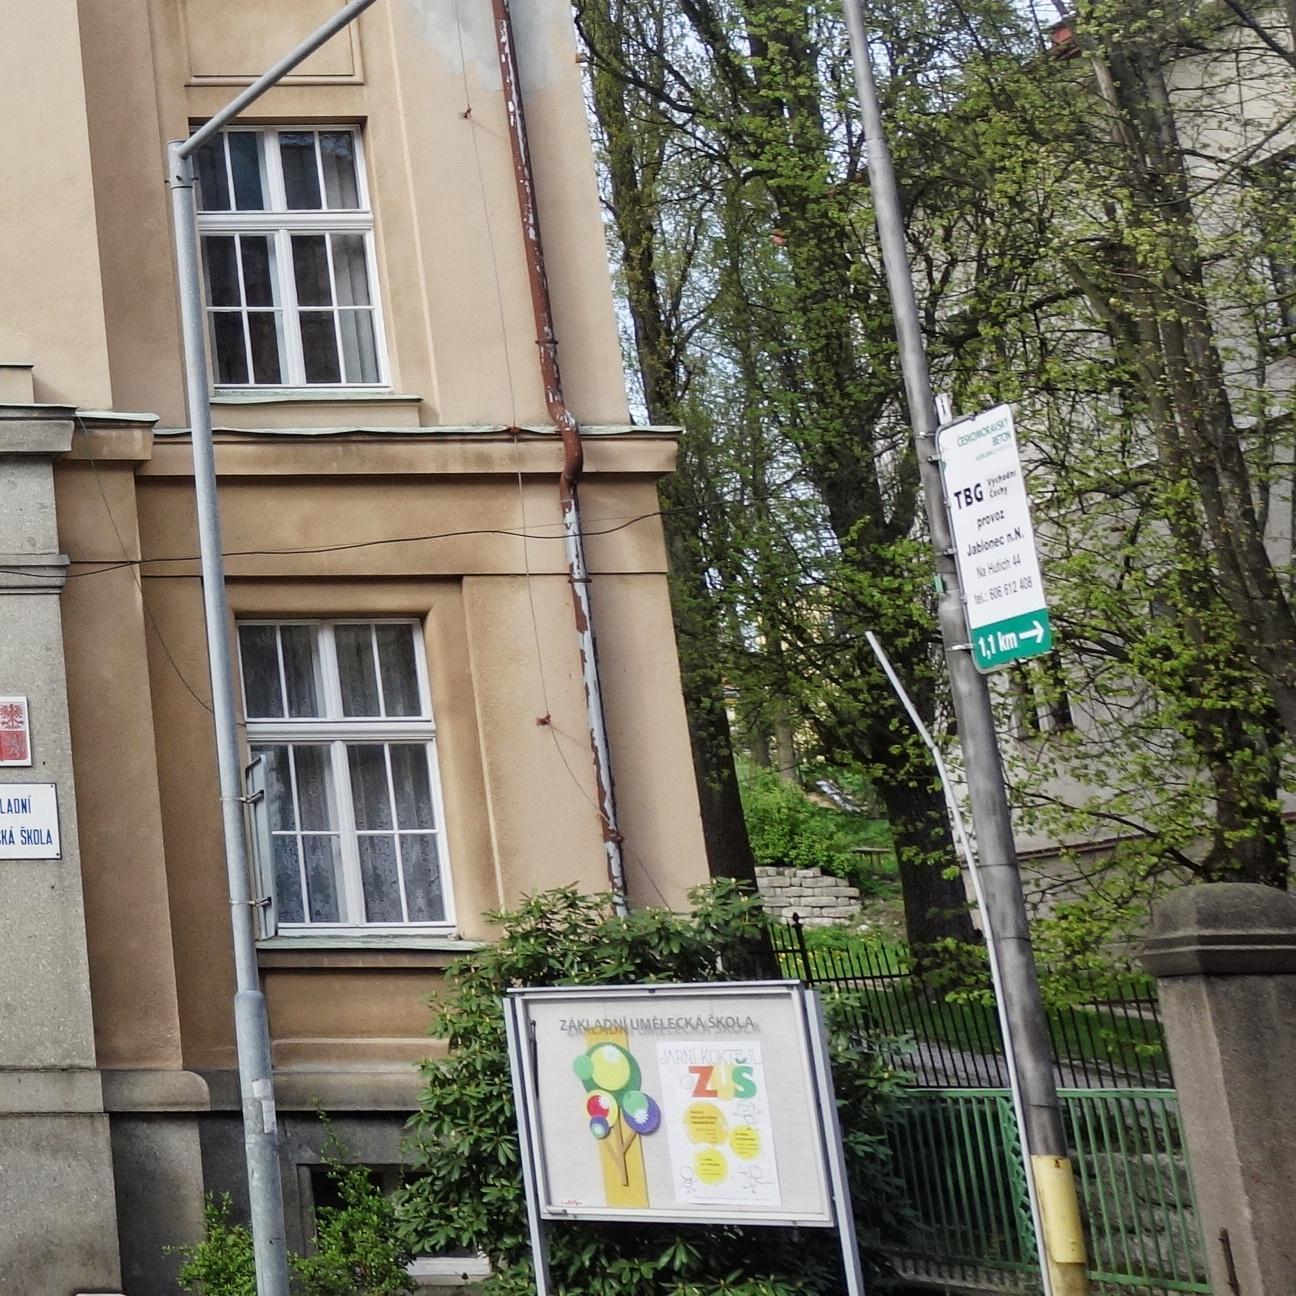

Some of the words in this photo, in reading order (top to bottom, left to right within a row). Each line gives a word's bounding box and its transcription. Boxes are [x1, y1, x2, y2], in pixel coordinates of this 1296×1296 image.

[954, 482, 984, 510] TBG
[977, 510, 1005, 531] provoz
[967, 536, 1005, 557] Jablonec
[1006, 526, 1025, 543] n.N.
[978, 634, 996, 660] 1,1
[997, 631, 1018, 652] km
[21, 825, 53, 846] ŠKOLA
[559, 1016, 627, 1031] ZÁKLADNÍ
[630, 1015, 704, 1030] UMĚLECKÁ
[708, 1015, 754, 1029] ŠKOLA
[688, 1058, 758, 1102] ZUŠ
